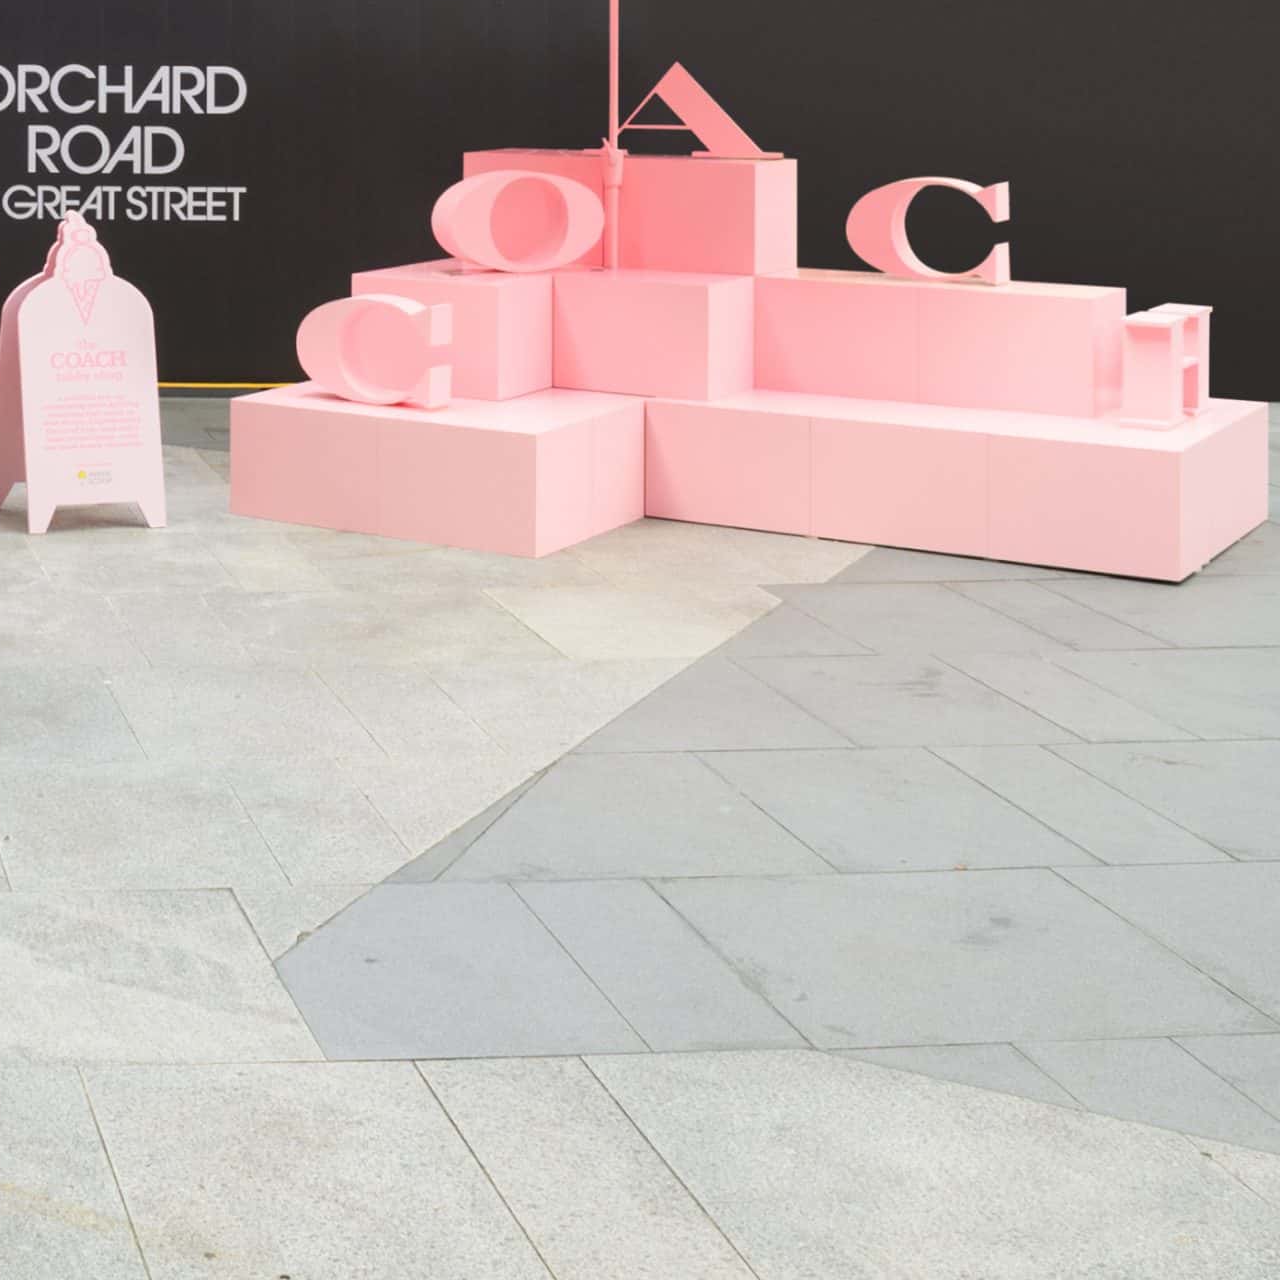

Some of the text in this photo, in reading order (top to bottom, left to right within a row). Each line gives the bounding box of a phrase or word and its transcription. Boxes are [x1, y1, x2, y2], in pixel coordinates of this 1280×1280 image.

[27, 124, 185, 175] ROAD
[2, 184, 122, 221] GREAT
[126, 185, 248, 222] STREET
[49, 350, 128, 369] COACH
